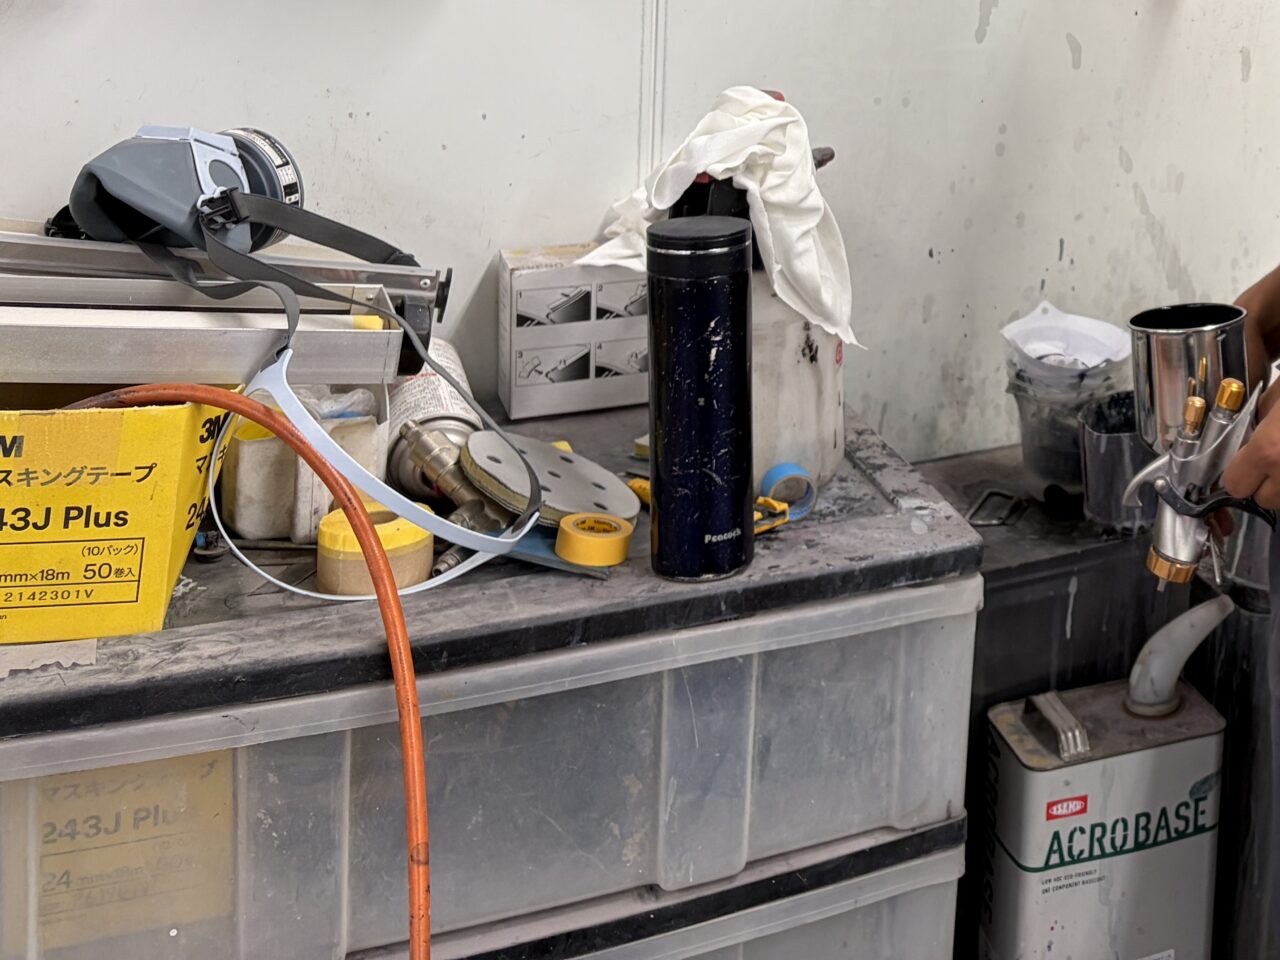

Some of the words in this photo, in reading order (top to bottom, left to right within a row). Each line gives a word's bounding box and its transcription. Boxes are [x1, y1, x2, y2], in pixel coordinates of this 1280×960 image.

[0, 463, 157, 488] スキングテープ
[63, 504, 129, 530] Plus
[185, 497, 212, 531] 24
[704, 528, 742, 544] Peacock
[81, 543, 140, 558] (10パック)
[42, 811, 122, 845] 243J
[133, 804, 192, 831] Plu
[1044, 795, 1209, 868] ACROBASE
[1052, 881, 1081, 892] COMPONENT
